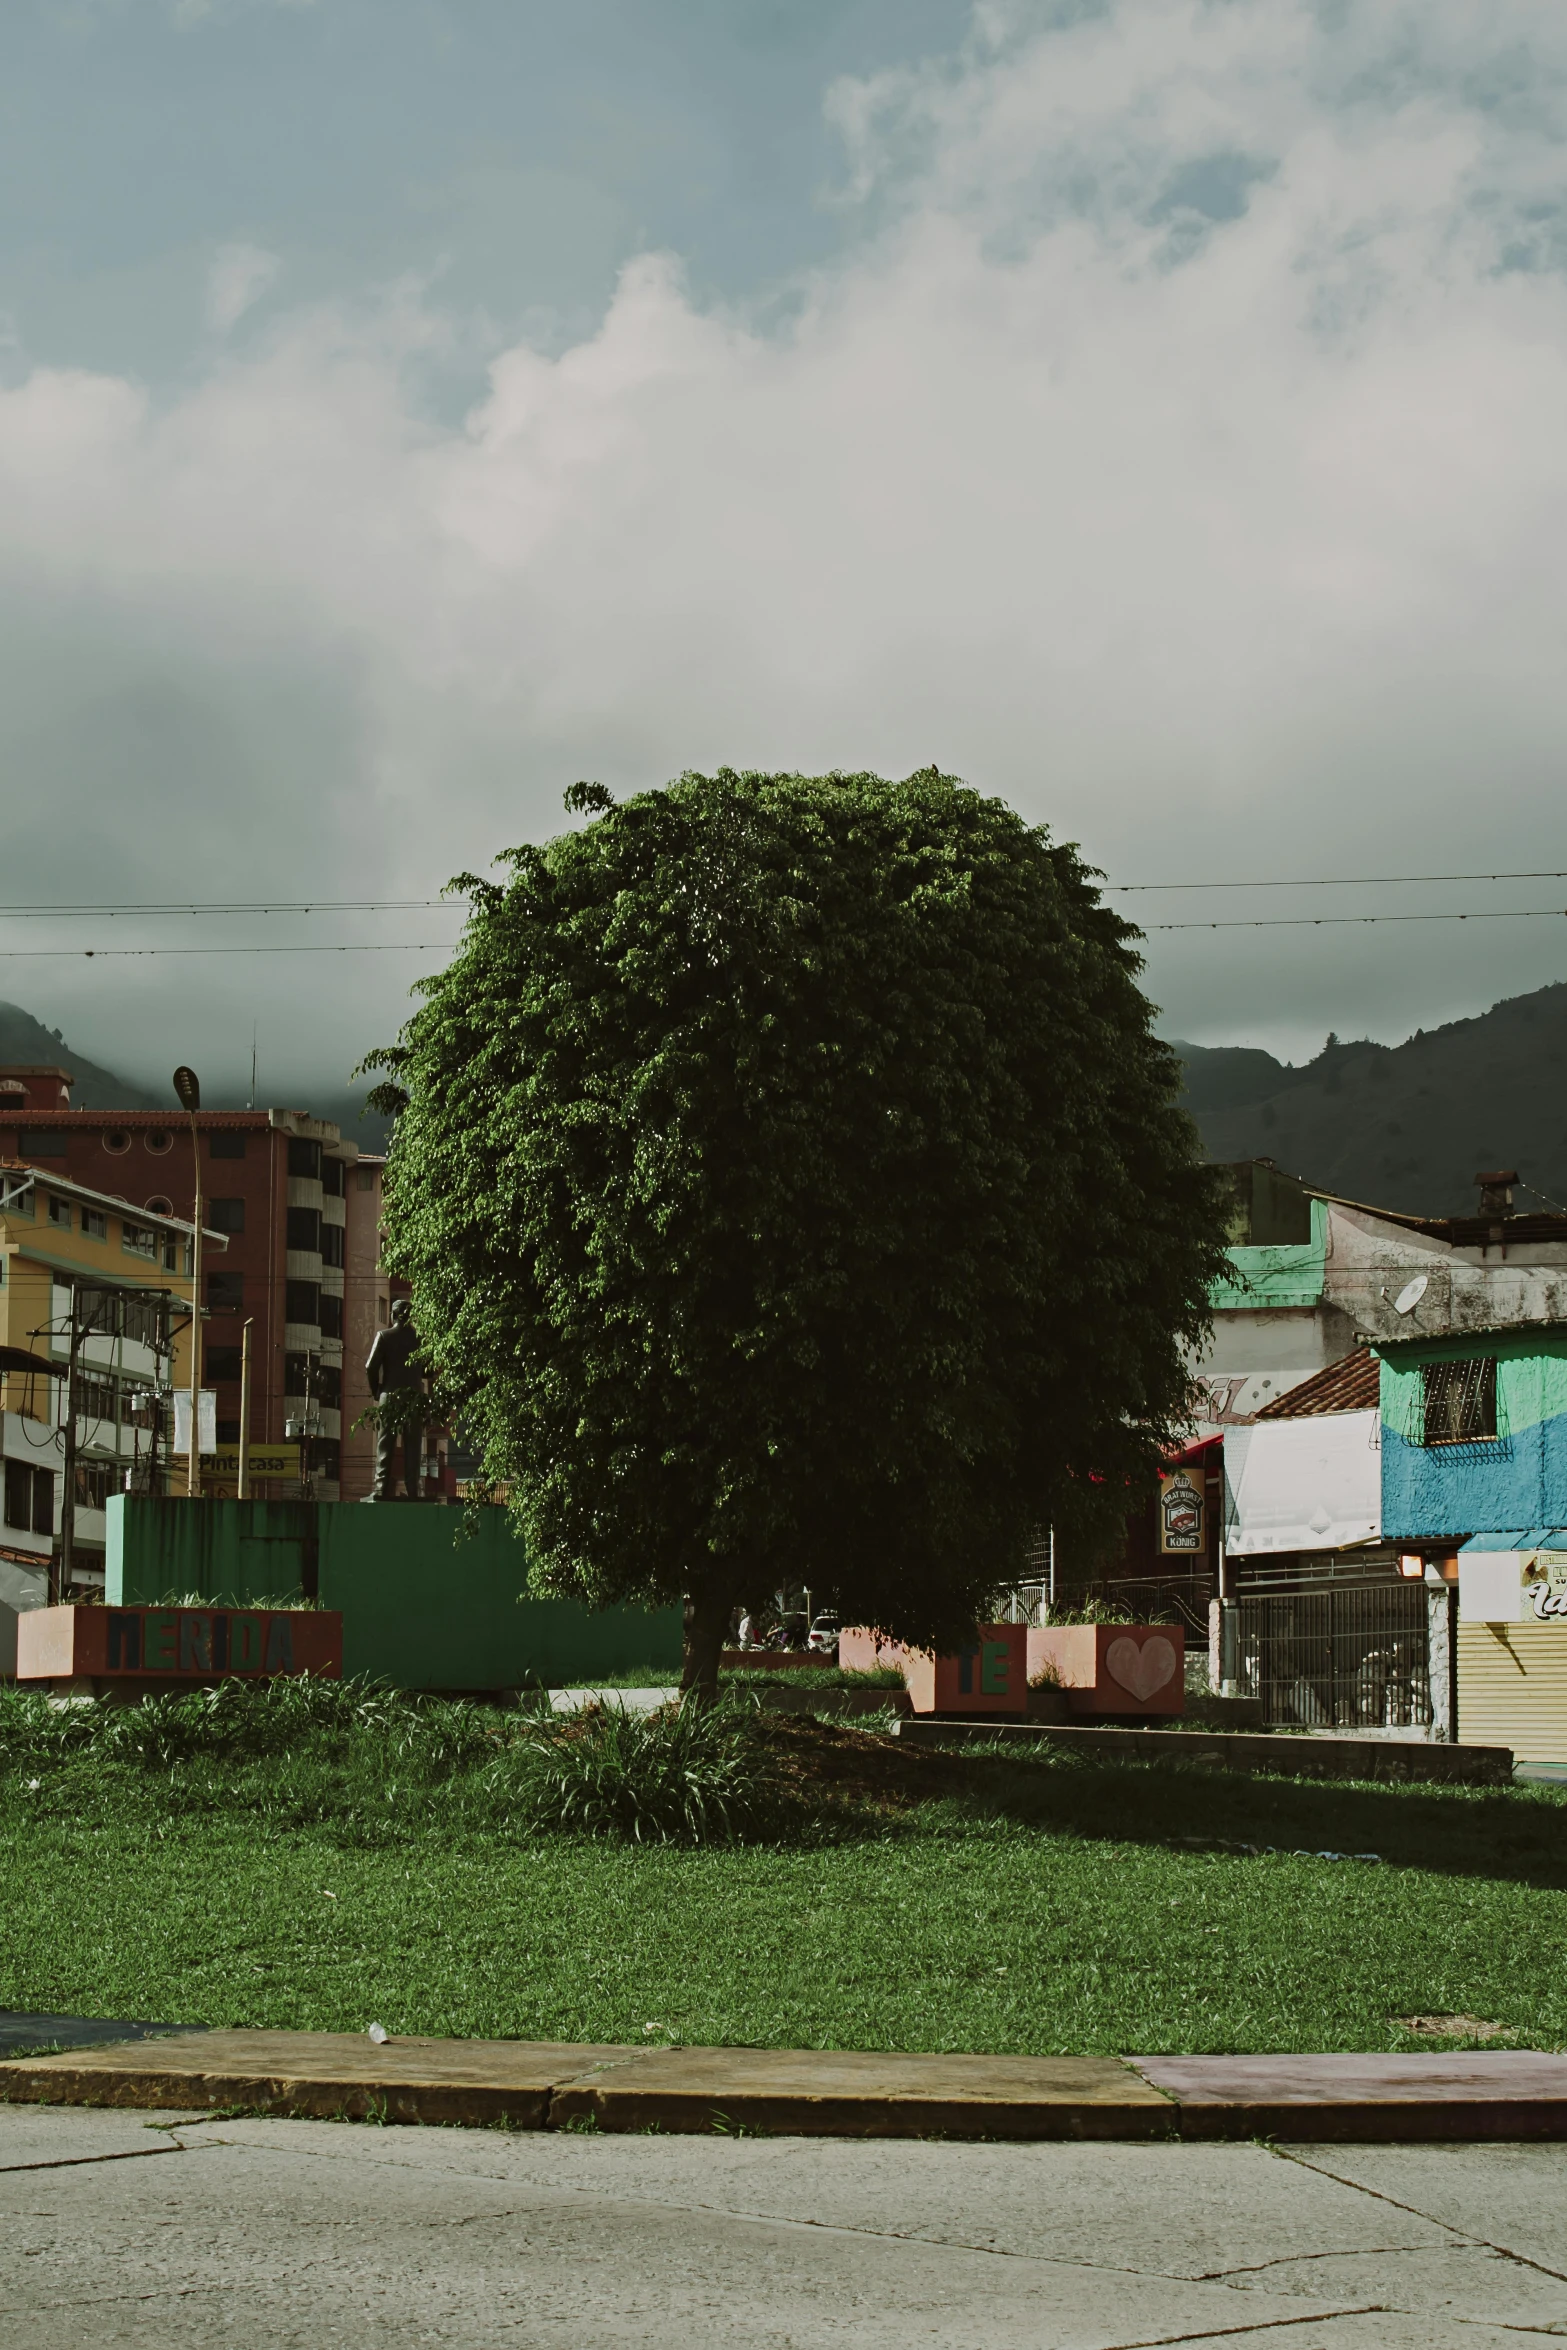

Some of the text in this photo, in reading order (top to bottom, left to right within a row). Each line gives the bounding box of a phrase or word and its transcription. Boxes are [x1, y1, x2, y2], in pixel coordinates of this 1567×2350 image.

[199, 1453, 285, 1471] Pintcasa
[1169, 1535, 1196, 1547] KÖNIG
[957, 1641, 1010, 1694] TE
